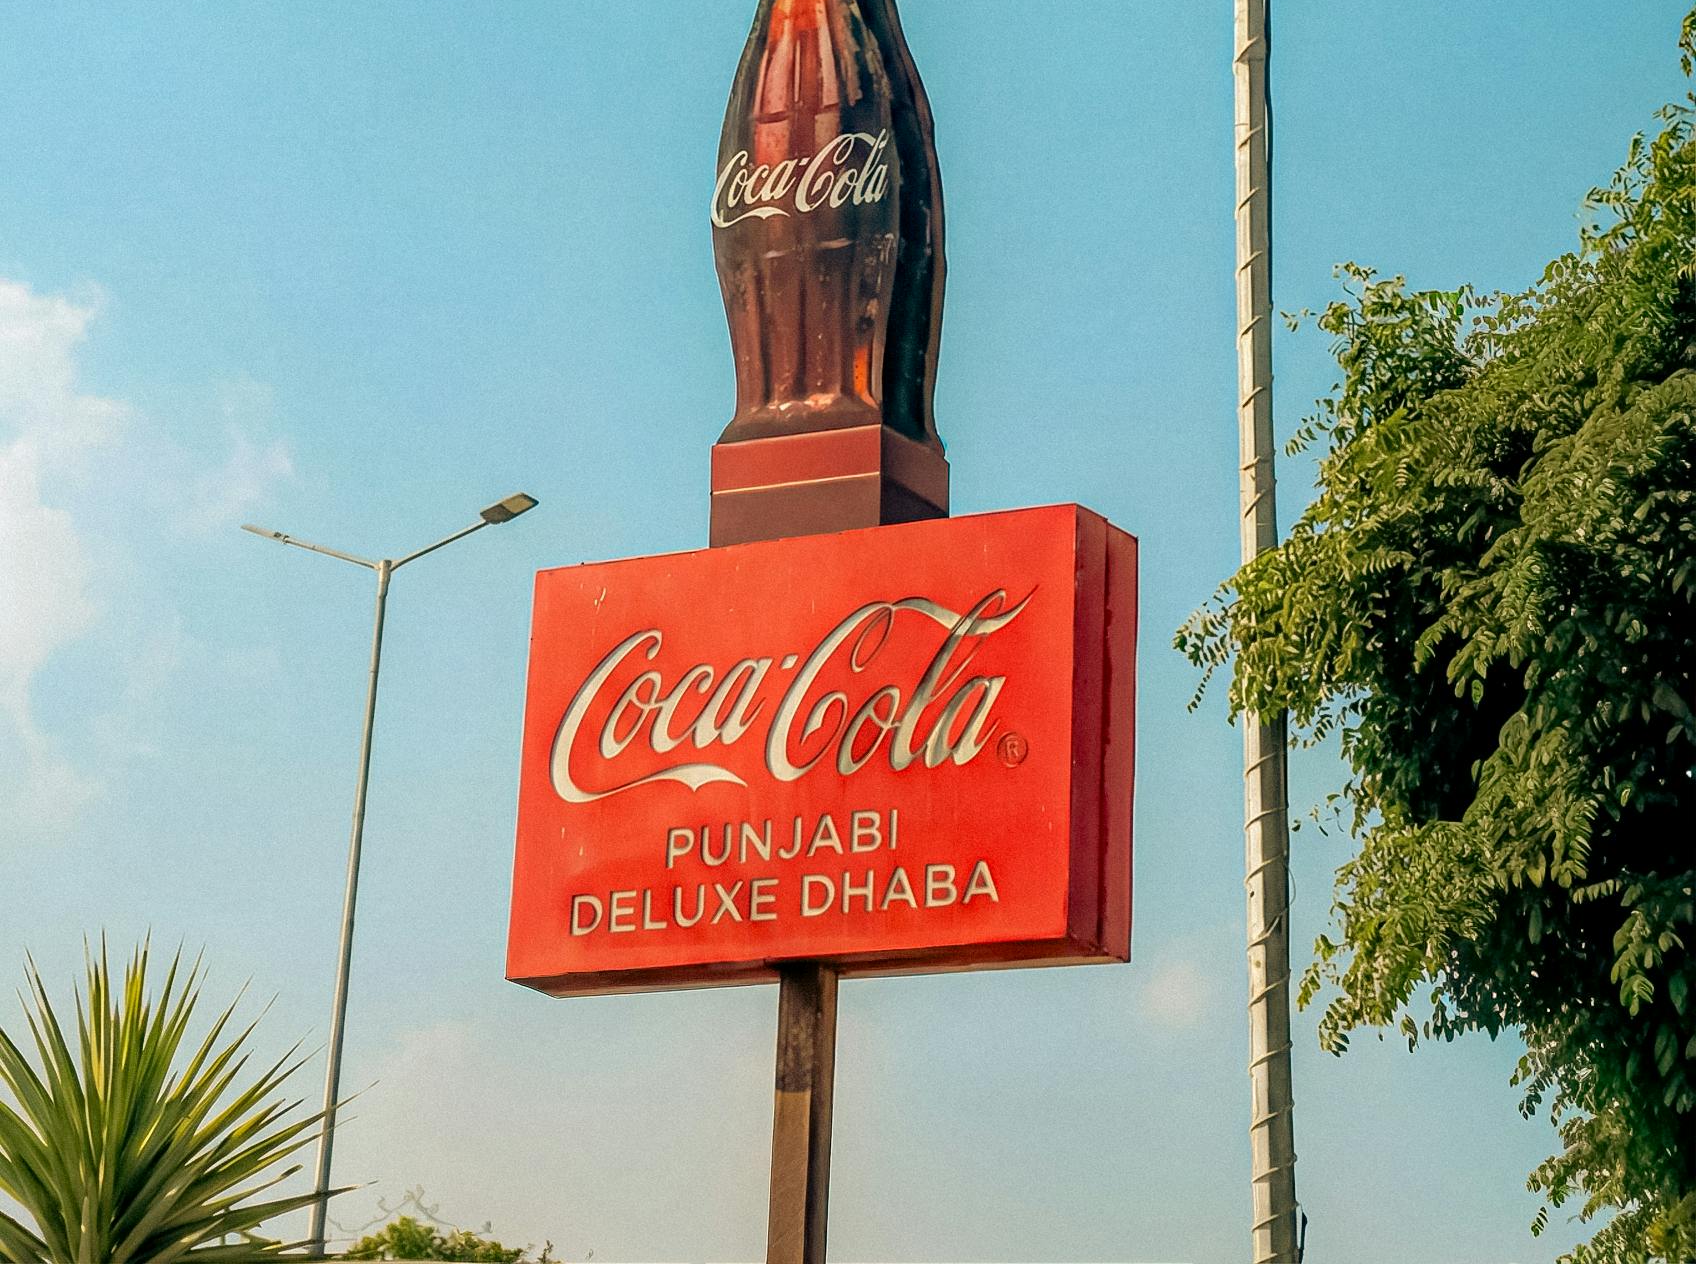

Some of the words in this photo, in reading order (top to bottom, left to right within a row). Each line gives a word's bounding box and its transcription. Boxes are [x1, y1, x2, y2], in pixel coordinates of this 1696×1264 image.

[711, 128, 889, 228] Coca-Cola
[550, 584, 1039, 803] Coca-Cola
[666, 809, 898, 869] PUNJABI
[571, 878, 779, 936] DELUXE
[801, 860, 999, 917] DHABA
